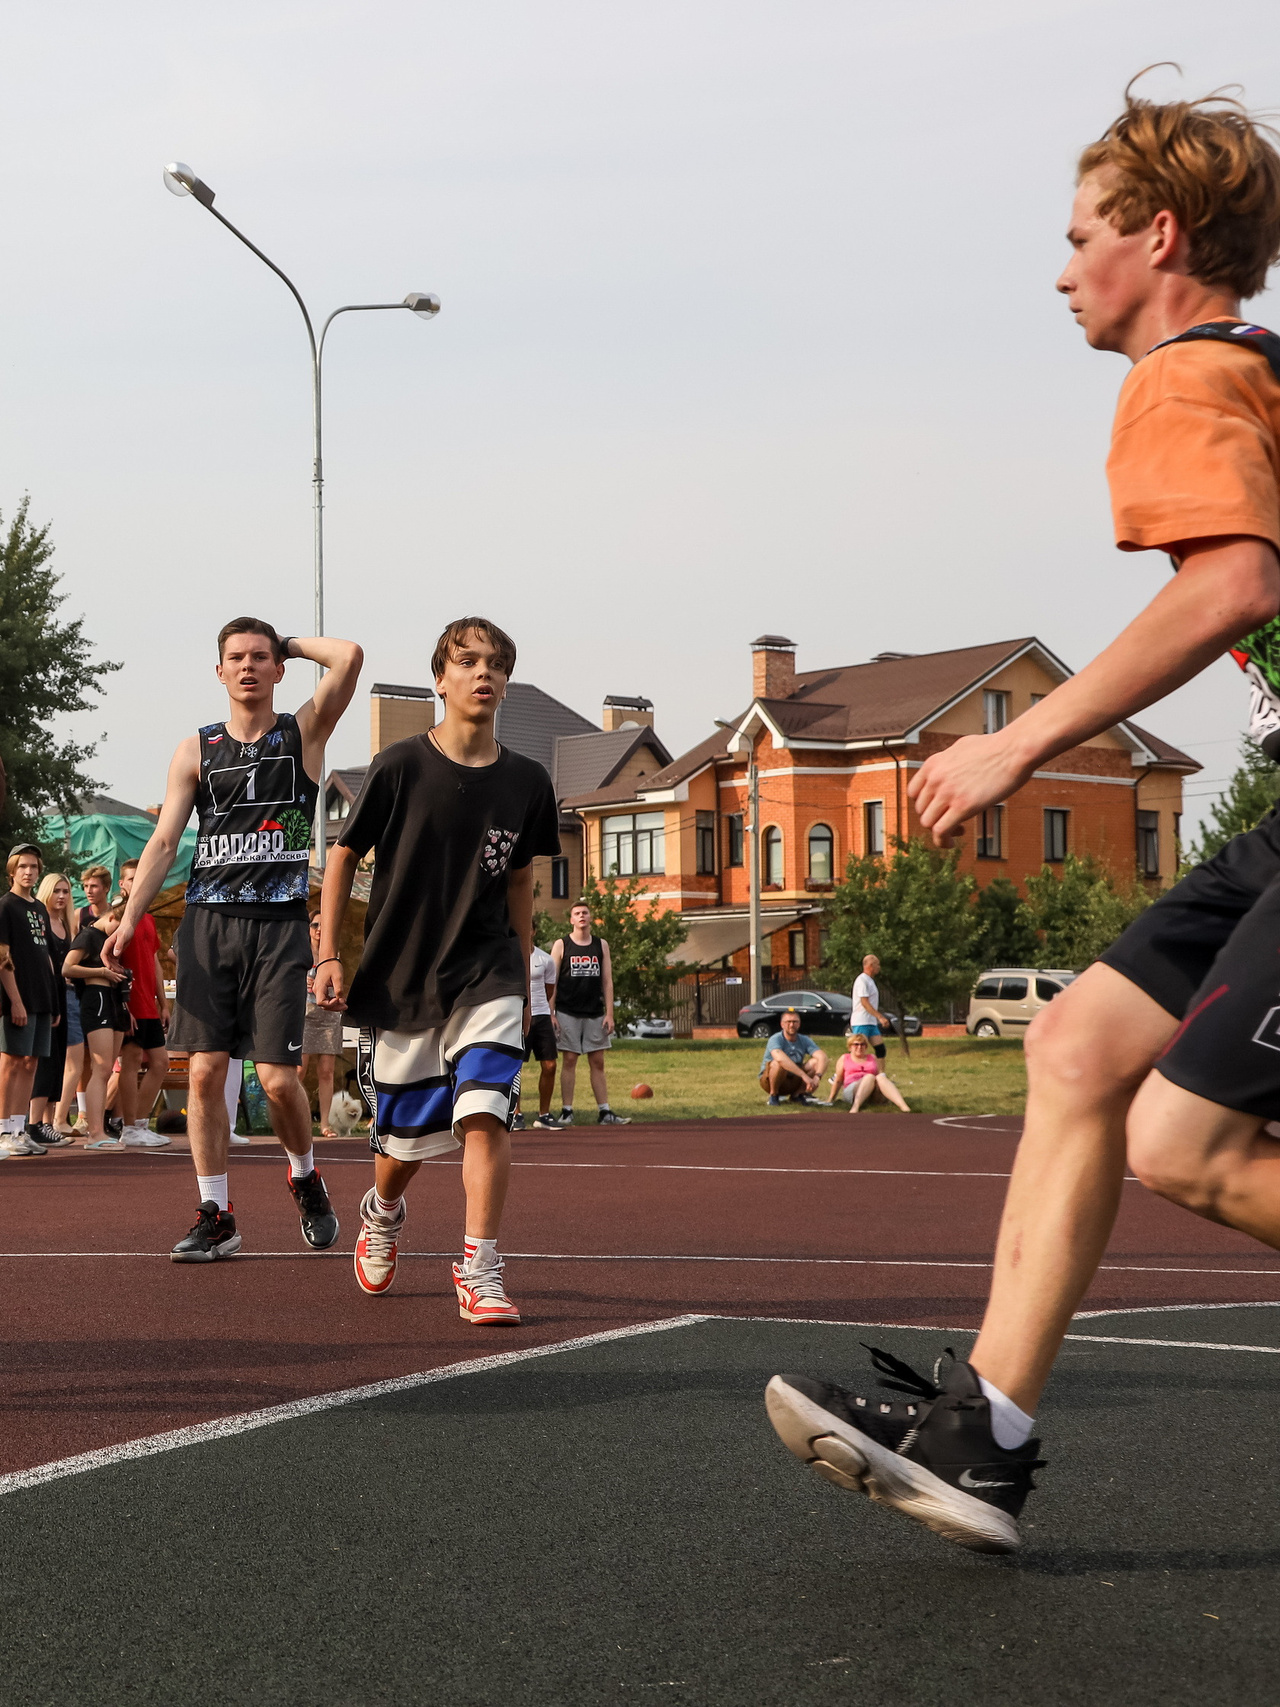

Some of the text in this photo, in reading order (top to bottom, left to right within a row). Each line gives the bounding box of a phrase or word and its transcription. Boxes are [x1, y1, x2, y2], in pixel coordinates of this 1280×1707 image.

[246, 767, 256, 800] 1
[270, 851, 308, 861] Москва
[570, 955, 600, 970] USA
